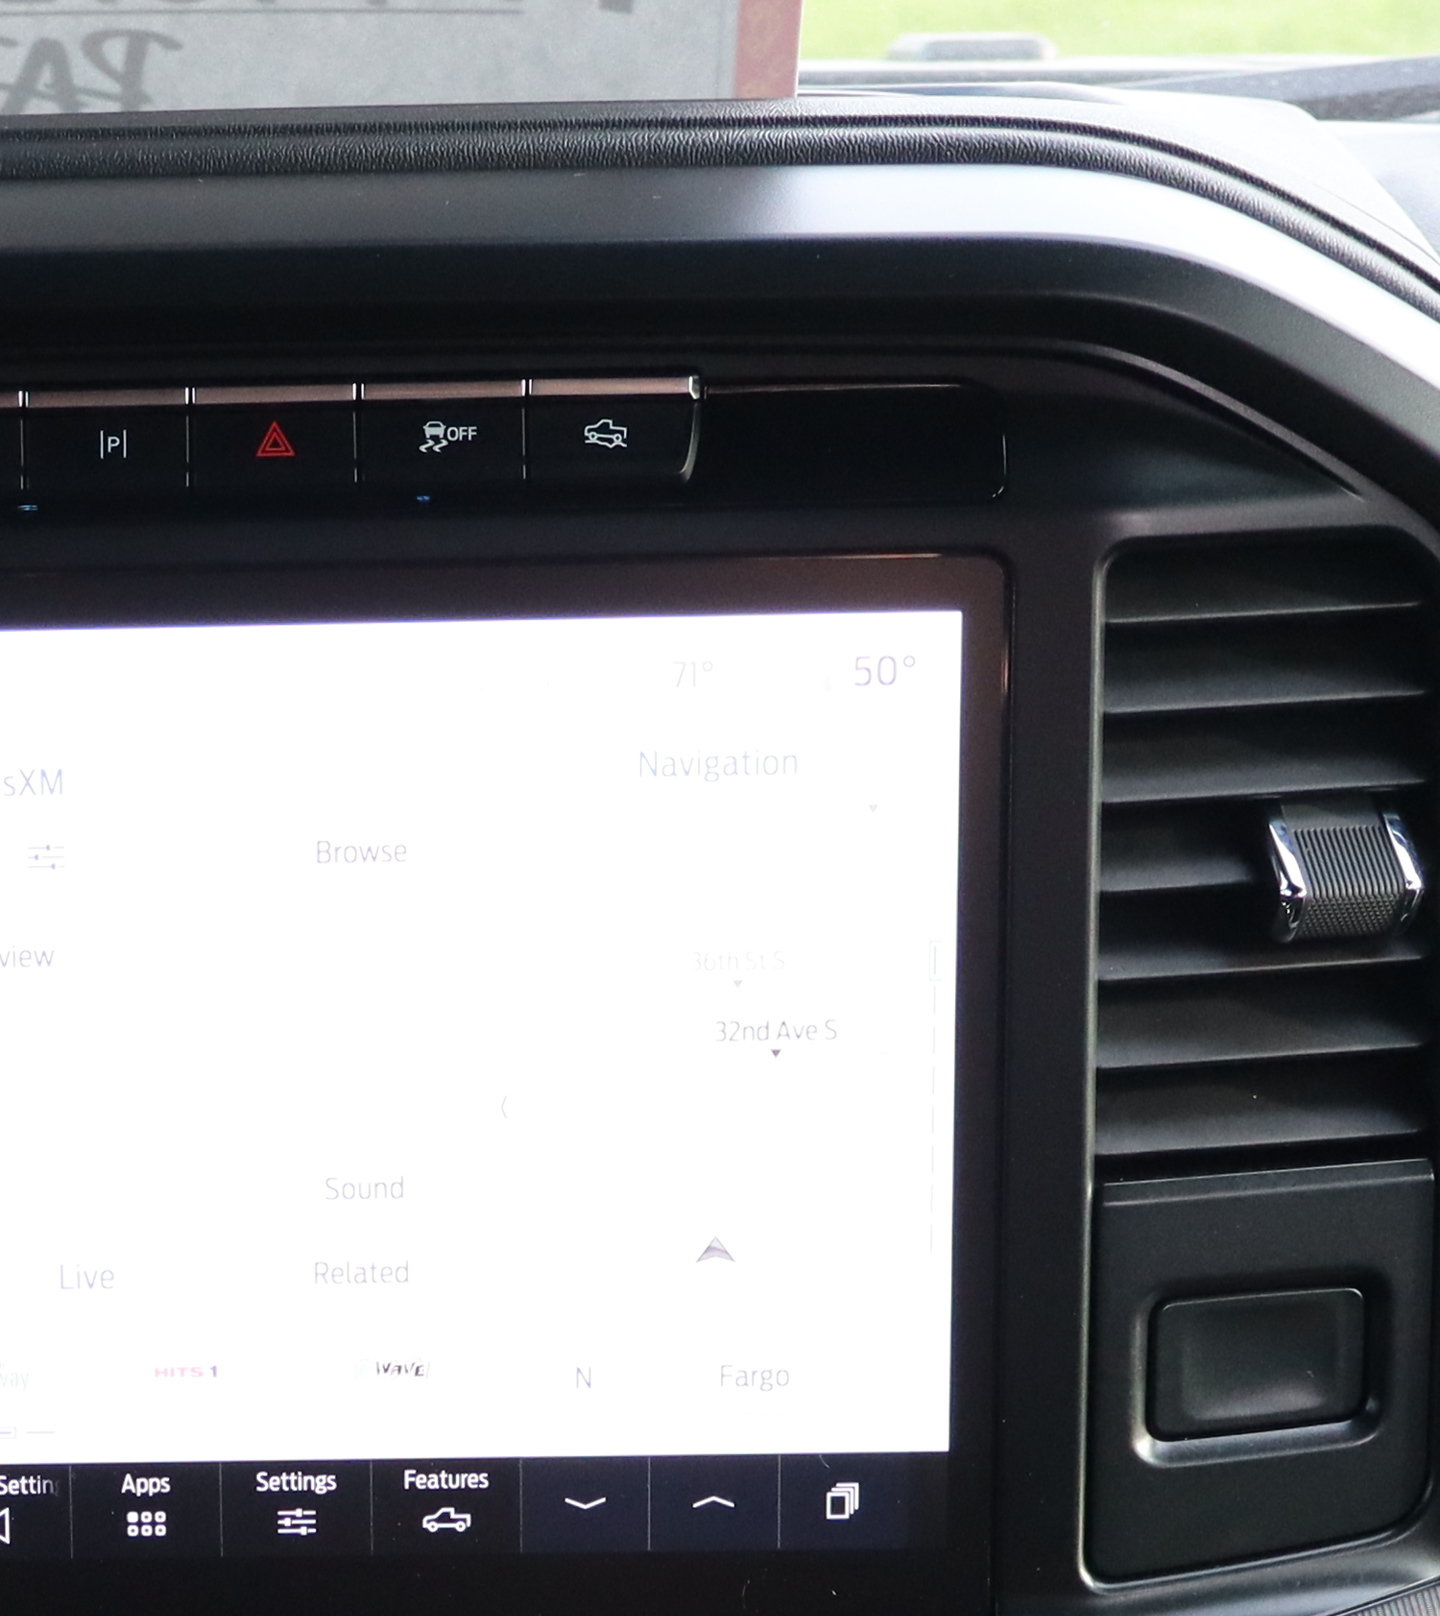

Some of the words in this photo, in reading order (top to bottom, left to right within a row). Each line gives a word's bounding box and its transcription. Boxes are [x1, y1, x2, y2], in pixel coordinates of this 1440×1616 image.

[447, 425, 478, 442] OFF
[853, 654, 917, 687] 50°
[638, 750, 799, 783] Navigation
[316, 839, 408, 864] Browse
[776, 1020, 818, 1041] Ave
[324, 1176, 405, 1200] Sound
[59, 1264, 115, 1290] Live
[314, 1260, 409, 1286] Related
[576, 1367, 592, 1389] N
[720, 1366, 790, 1392] Fargo
[121, 1474, 171, 1498] Apps
[256, 1472, 337, 1495] Settings
[403, 1470, 489, 1490] Features
